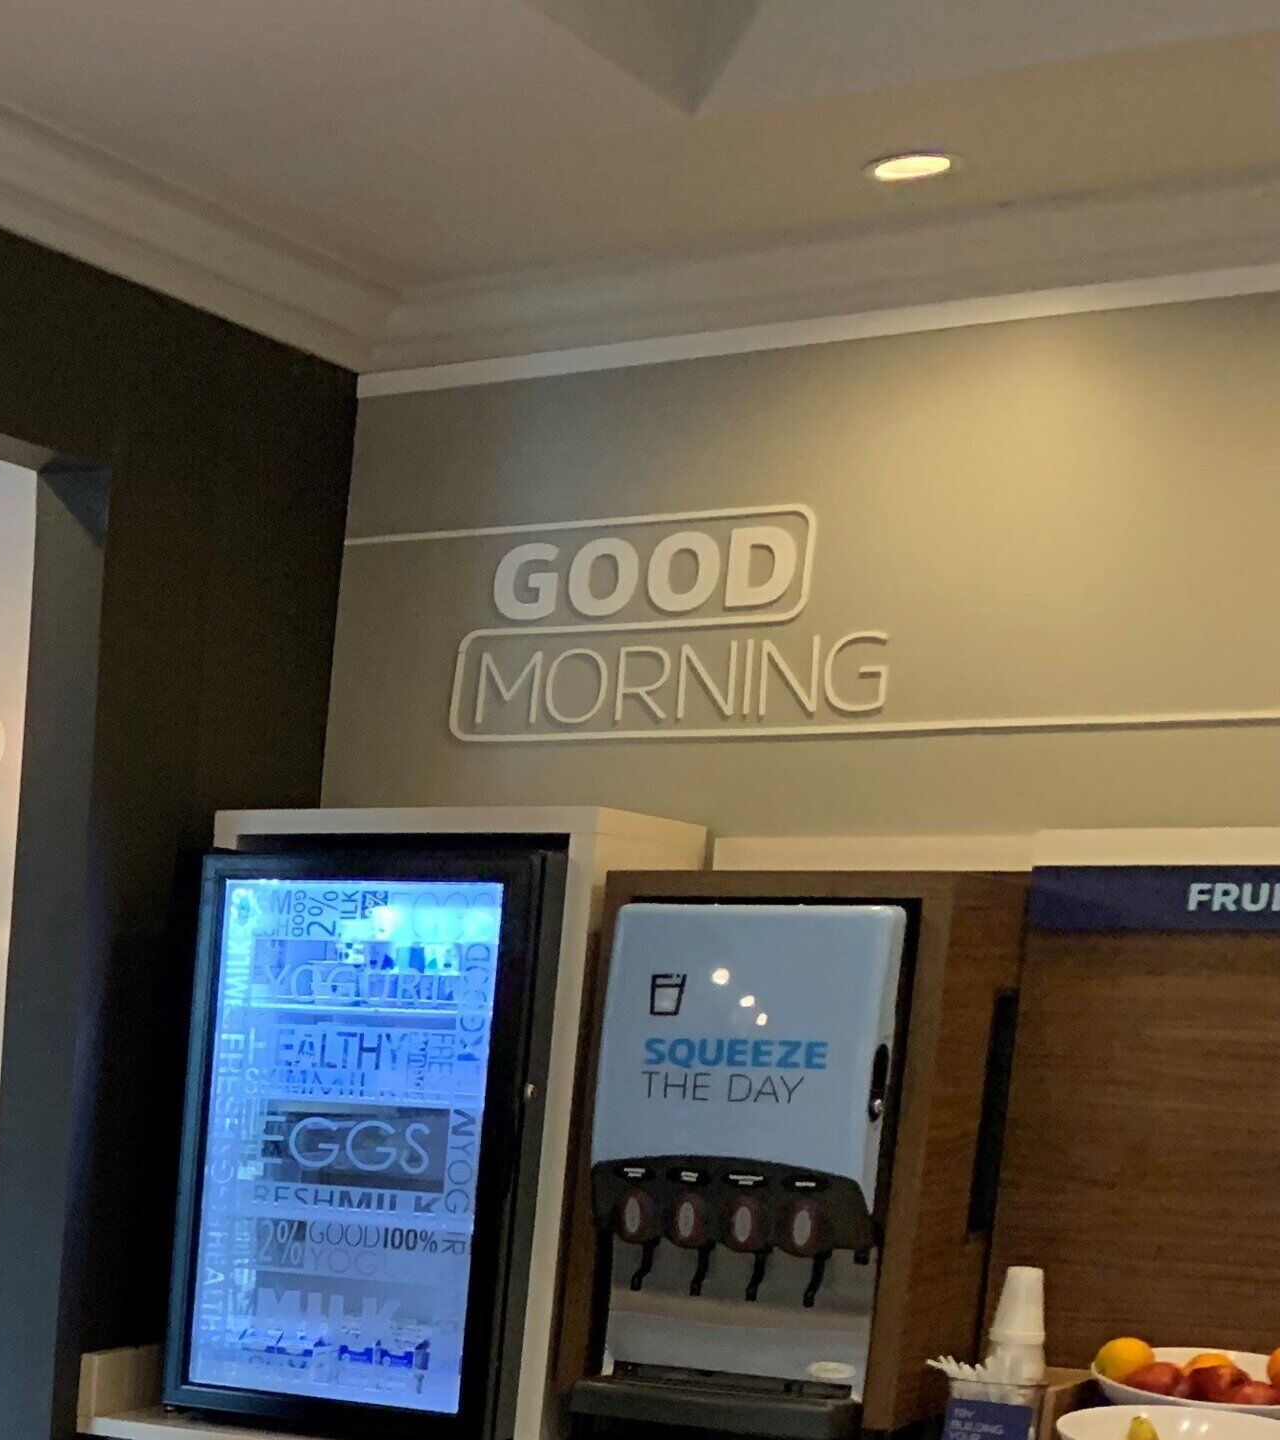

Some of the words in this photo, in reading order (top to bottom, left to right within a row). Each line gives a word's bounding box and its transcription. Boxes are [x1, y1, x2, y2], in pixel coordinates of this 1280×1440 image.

[493, 526, 797, 621] GOOD
[474, 631, 889, 725] MORNING
[643, 1038, 828, 1070] SQUEEZE
[641, 1071, 709, 1102] THE
[728, 1073, 804, 1104] DAY
[259, 1114, 431, 1175] EGGS
